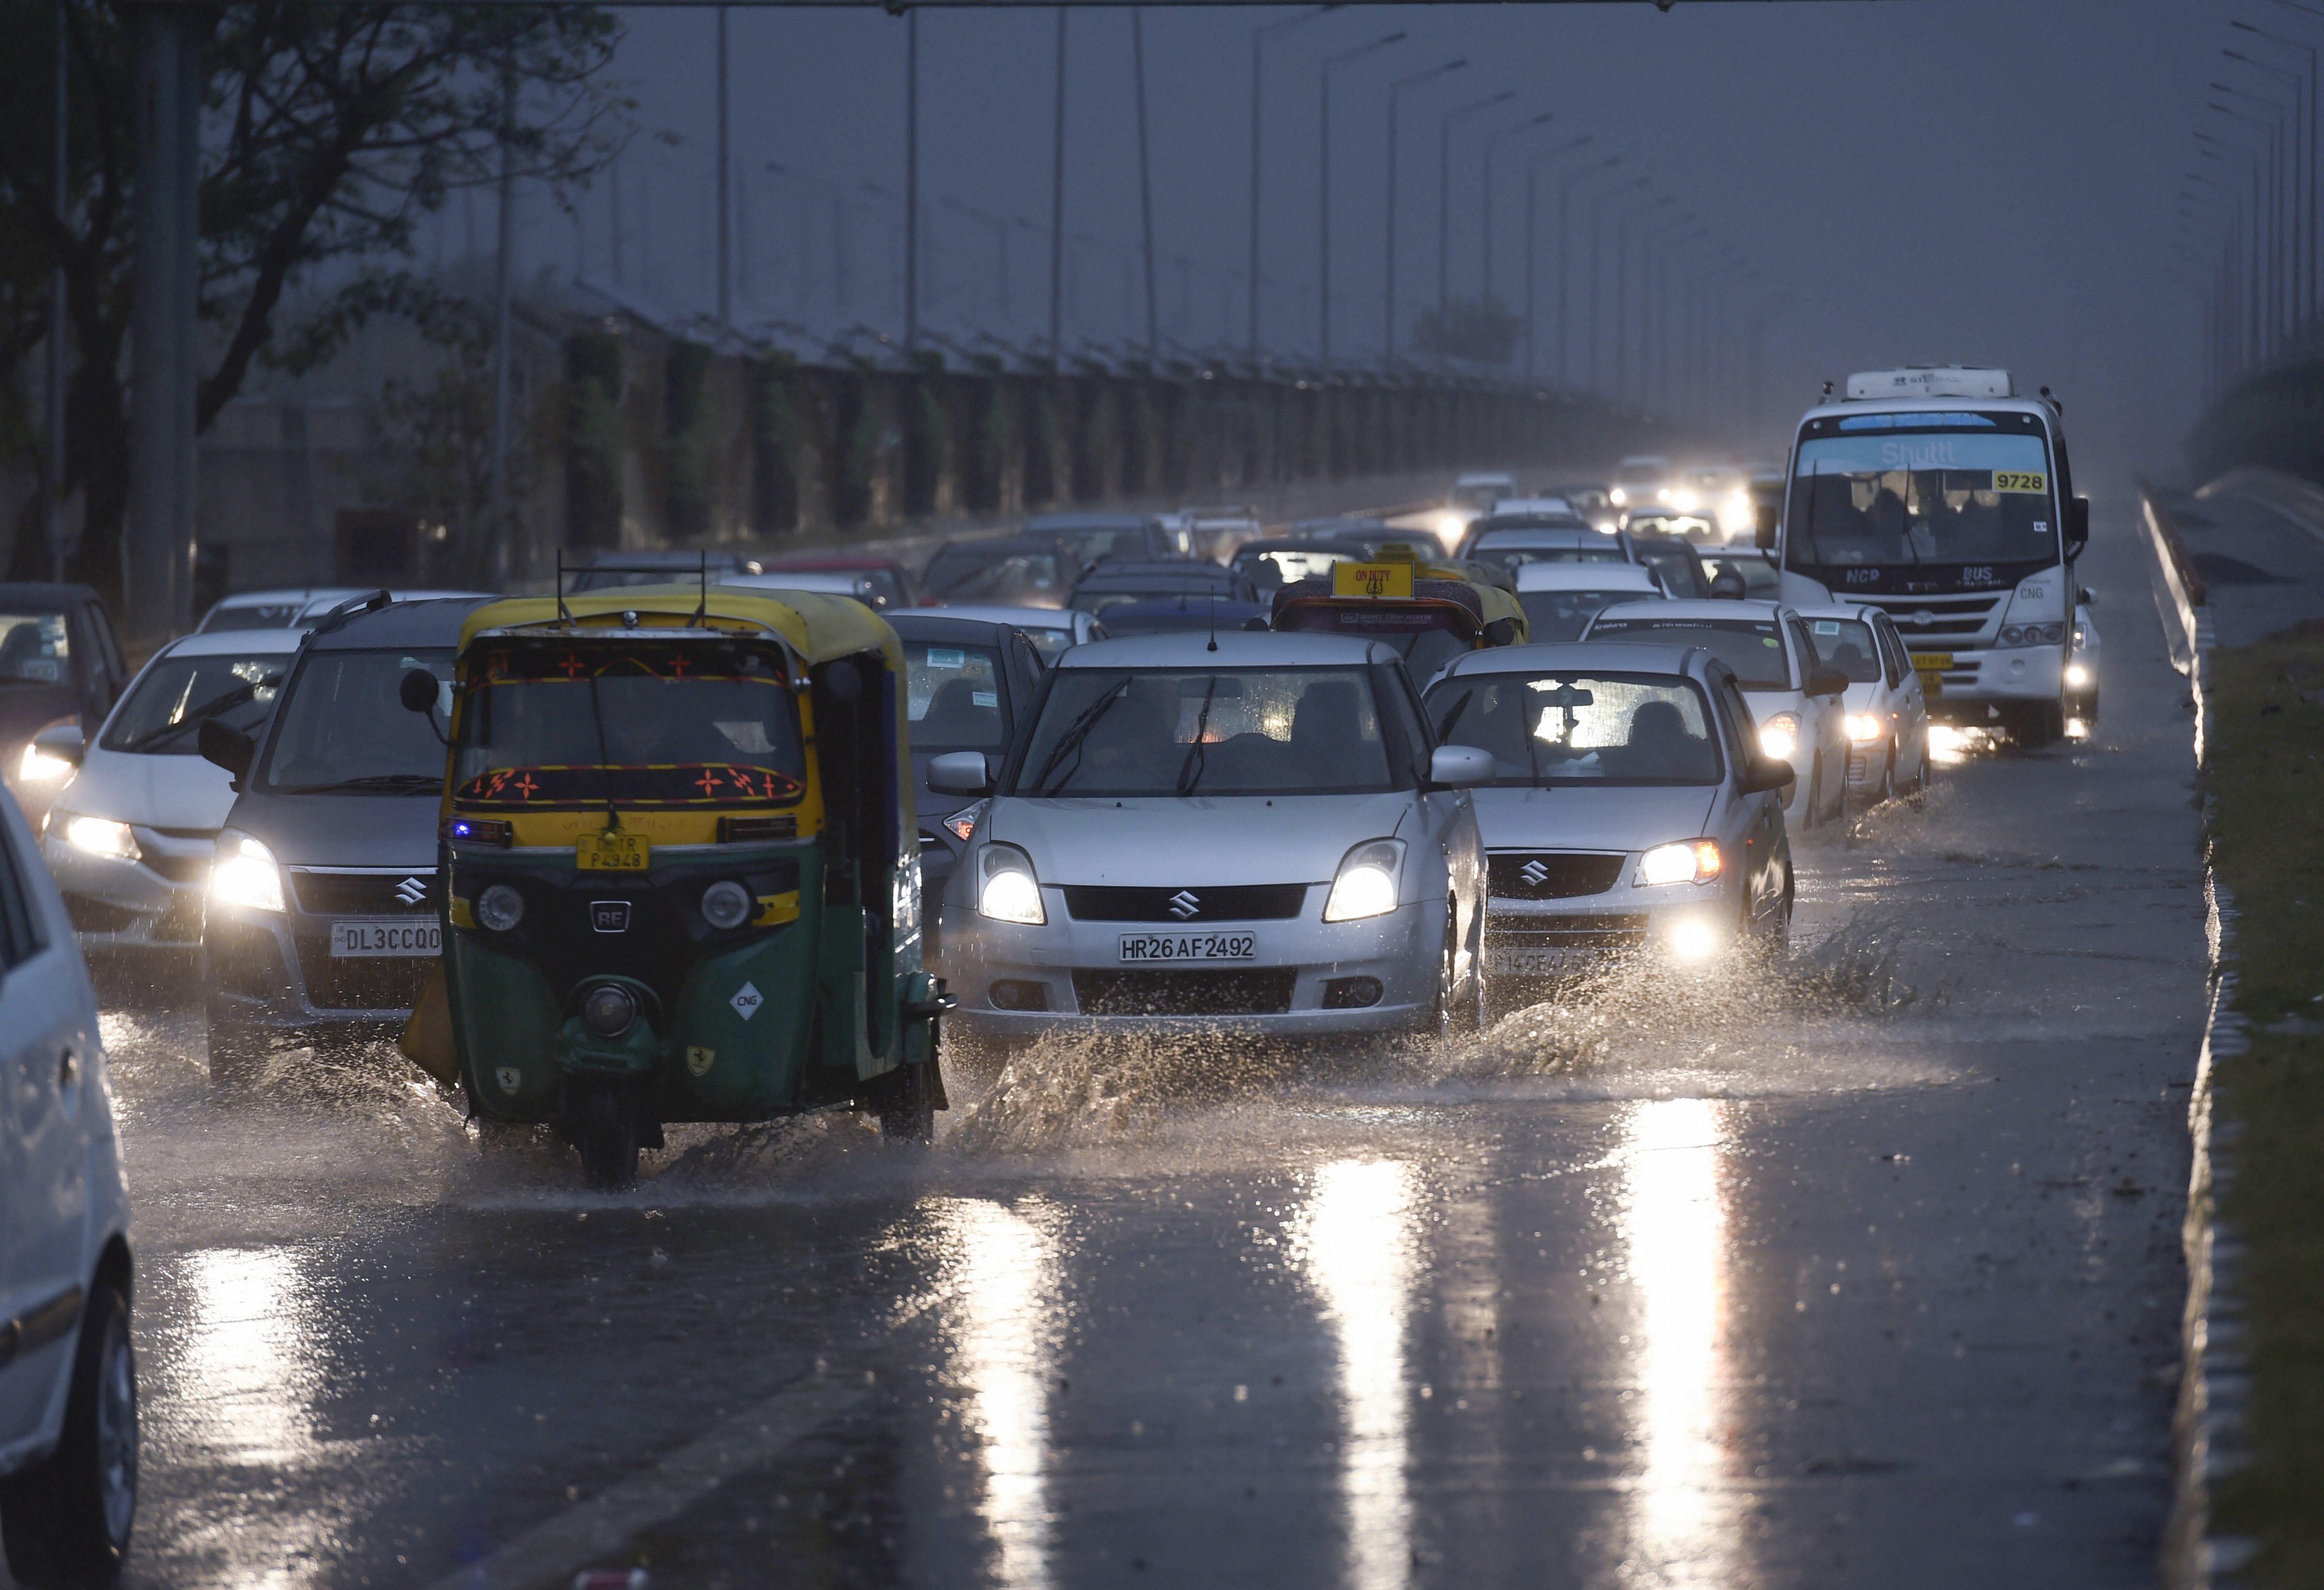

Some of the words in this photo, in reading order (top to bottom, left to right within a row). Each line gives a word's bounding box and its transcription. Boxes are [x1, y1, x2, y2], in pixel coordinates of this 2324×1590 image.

[1997, 475, 2043, 490] 9728
[1356, 570, 1367, 582] ON
[1369, 570, 1391, 582] DUTY
[1846, 568, 1881, 583] NCR
[1963, 566, 1993, 580] BUS
[2020, 587, 2044, 599] CNG
[597, 911, 623, 926] RE
[1122, 937, 1254, 958] HR26AF2492
[737, 995, 757, 1006] CNG
